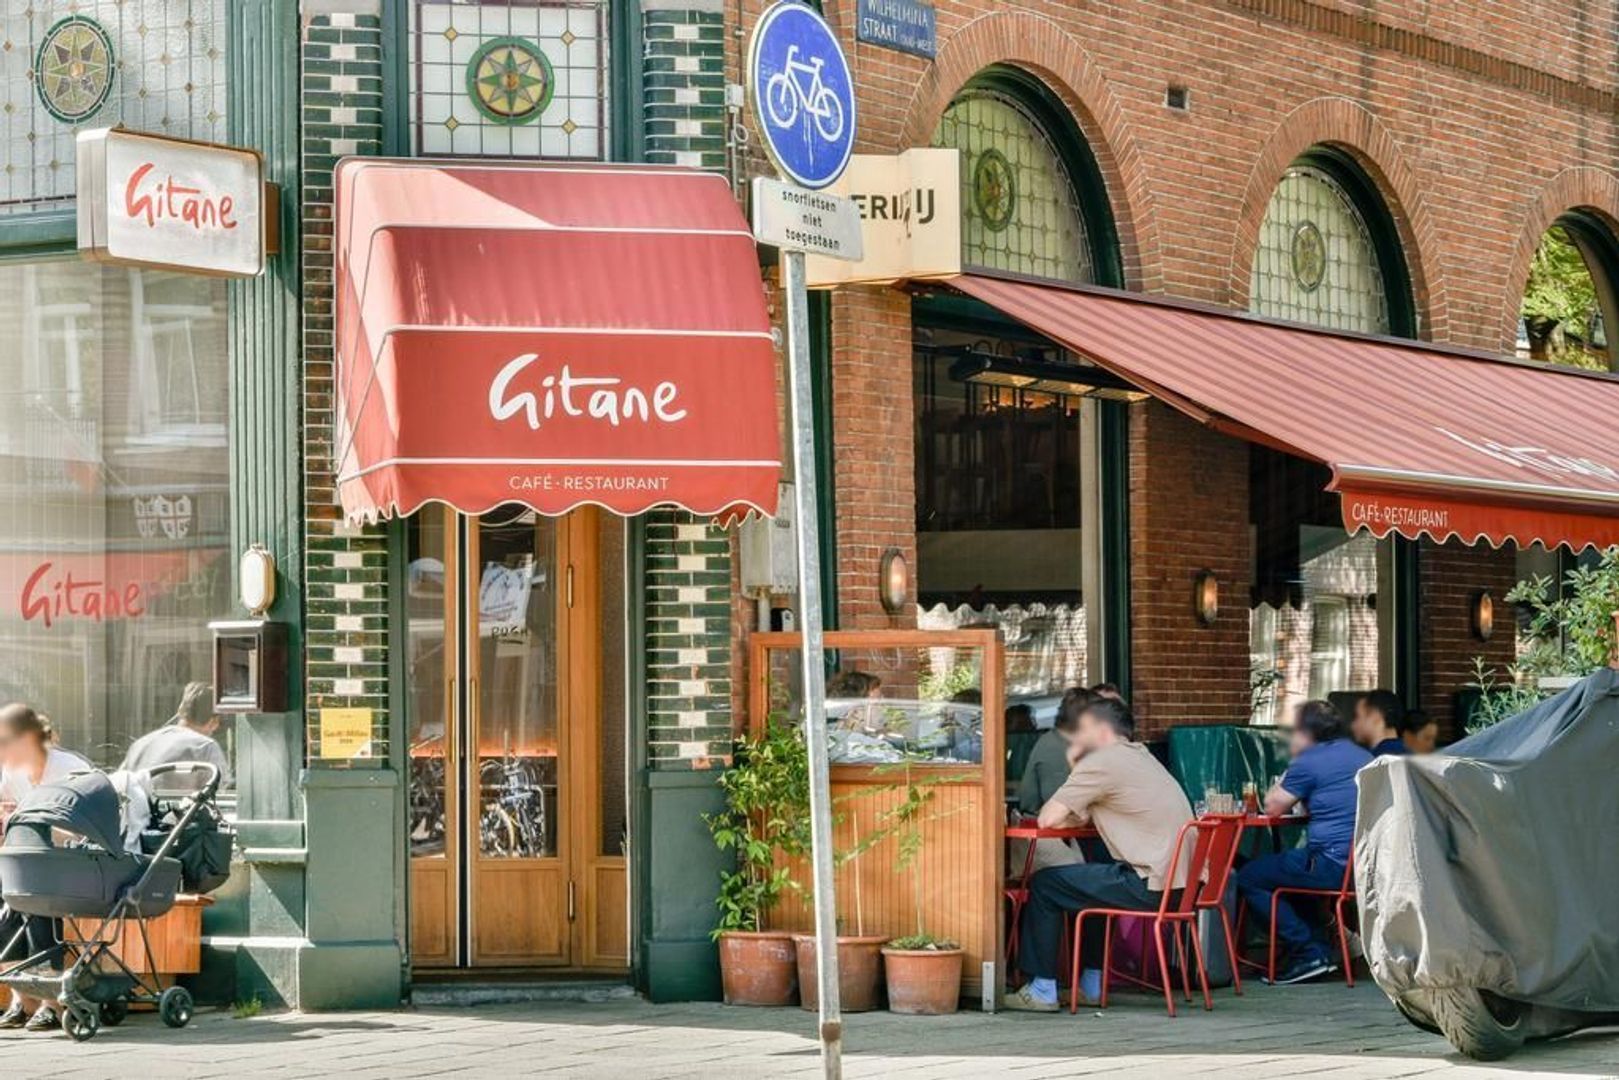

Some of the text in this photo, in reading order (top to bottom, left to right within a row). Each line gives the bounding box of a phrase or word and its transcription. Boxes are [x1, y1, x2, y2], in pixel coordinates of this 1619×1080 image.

[863, 17, 897, 42] STRAAT
[126, 163, 237, 229] Gitane
[782, 190, 837, 213] snorfietsen
[802, 212, 822, 228] niet
[785, 227, 840, 251] toegestaan
[489, 353, 688, 430] Gitane
[21, 562, 145, 628] Gitane
